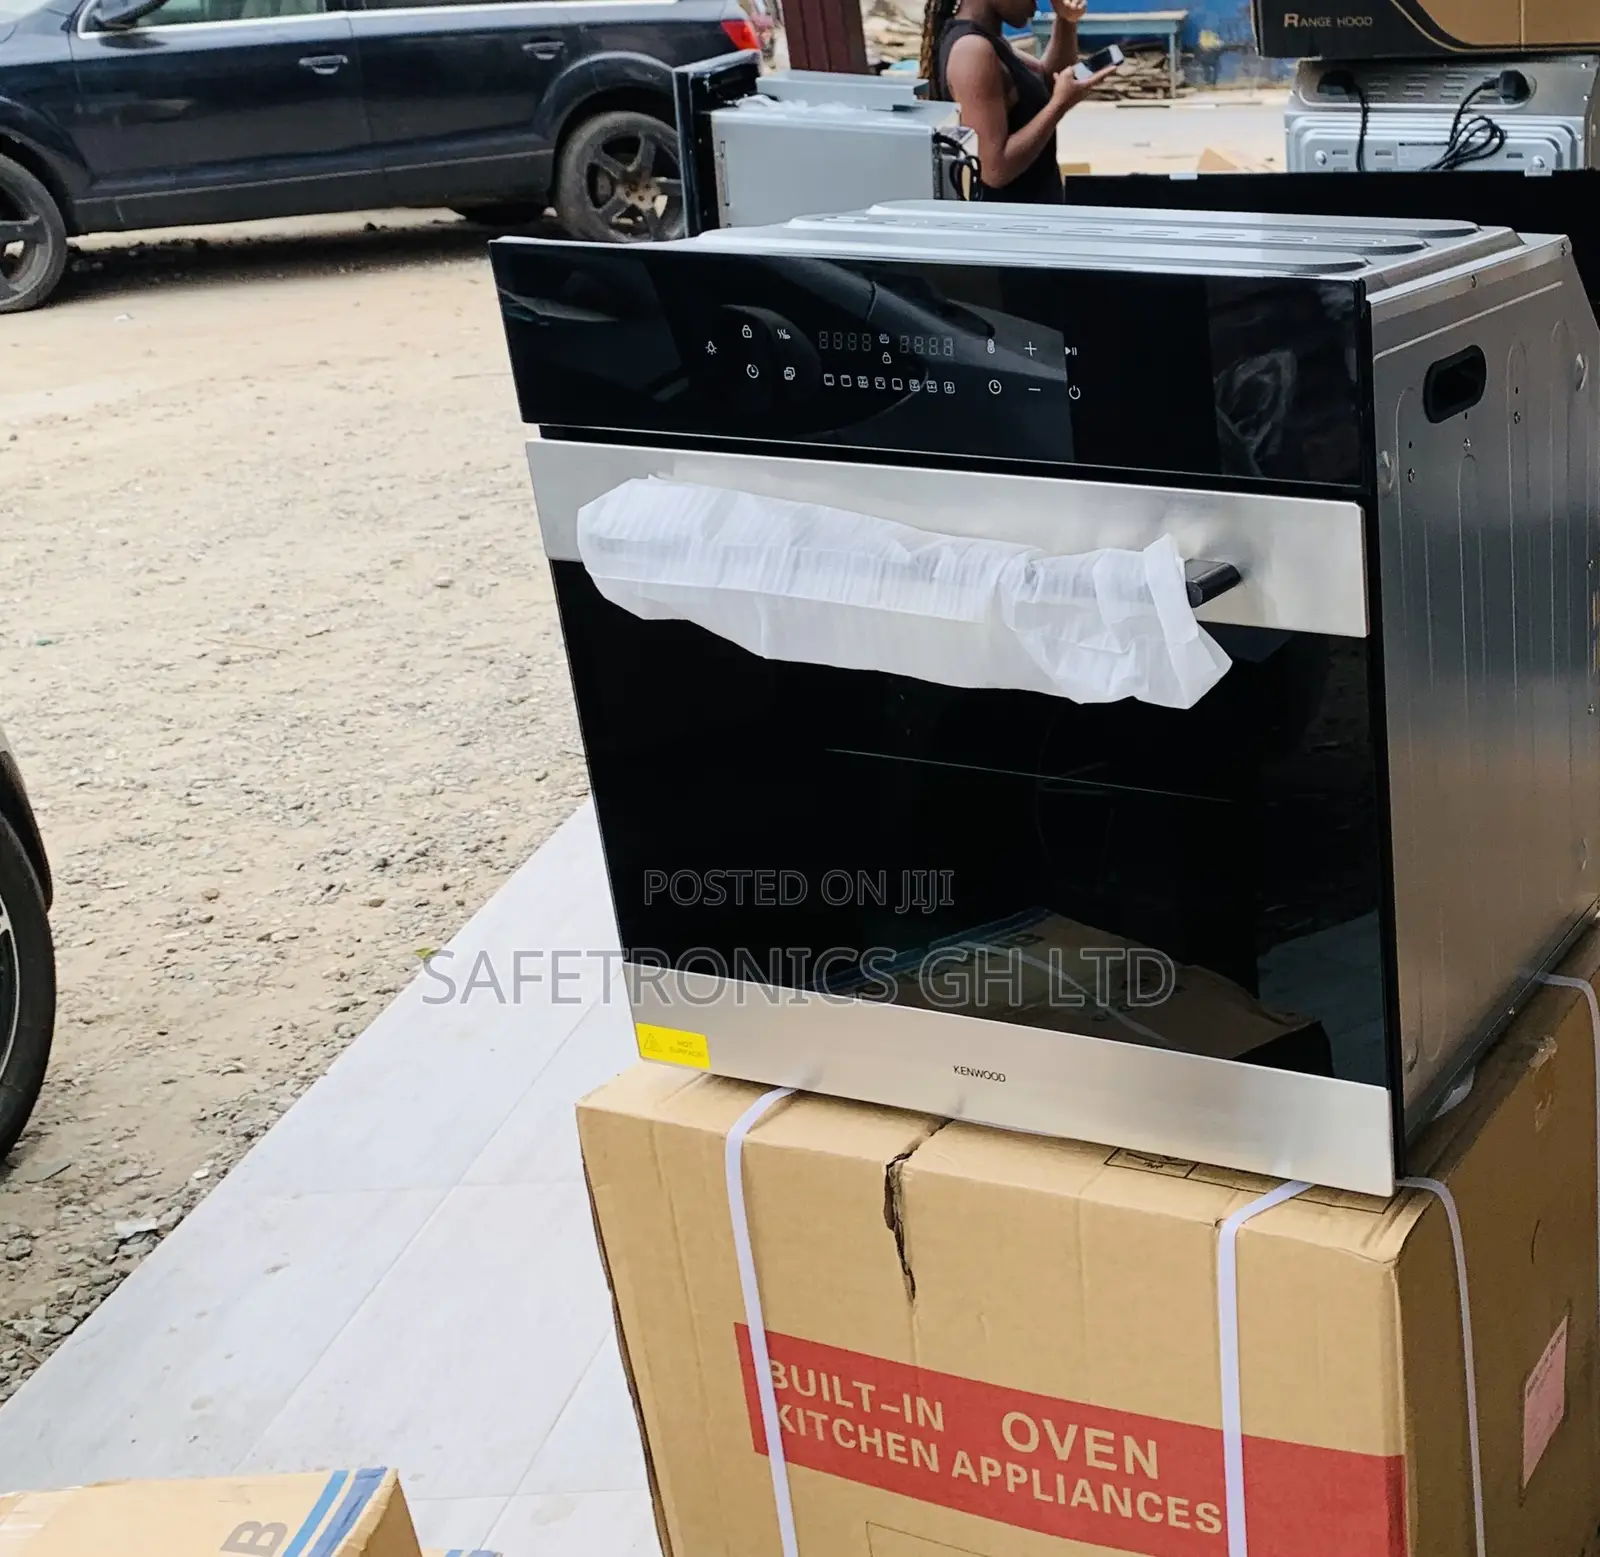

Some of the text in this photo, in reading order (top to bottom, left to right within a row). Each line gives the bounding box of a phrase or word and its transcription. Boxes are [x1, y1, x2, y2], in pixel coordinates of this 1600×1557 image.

[1284, 13, 1373, 28] RANGE HOOD
[952, 1065, 1006, 1083] KENWOOD
[770, 1359, 1159, 1479] BUILT-IN OVEN
[779, 1404, 1223, 1534] KITCHEN APPLIANCES
